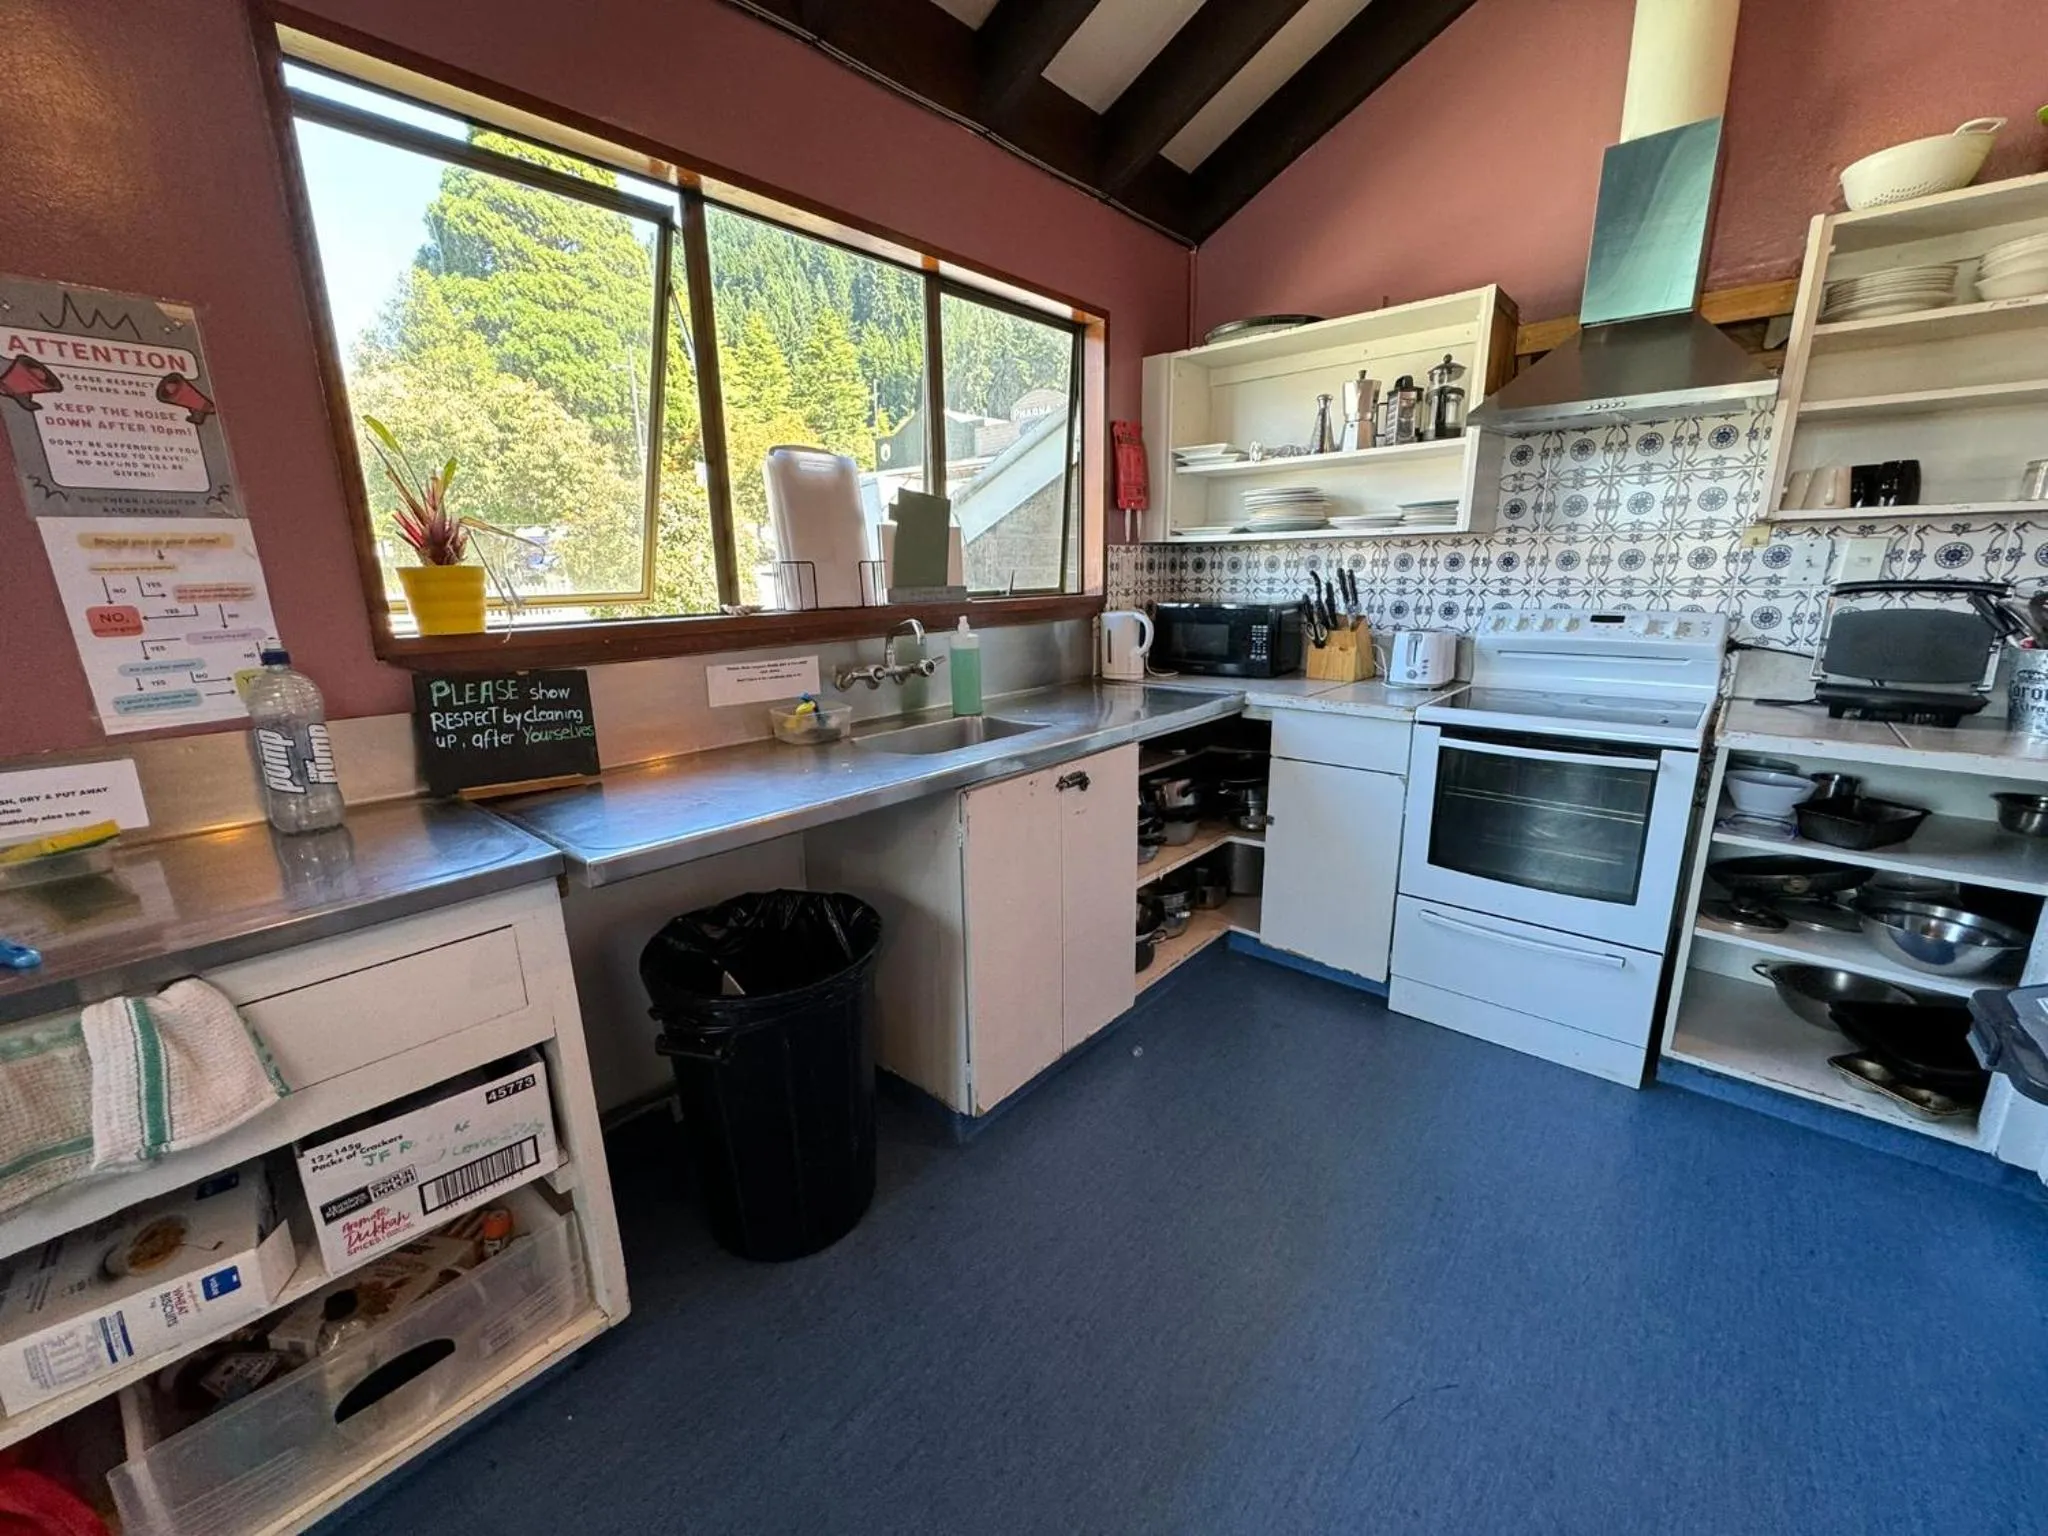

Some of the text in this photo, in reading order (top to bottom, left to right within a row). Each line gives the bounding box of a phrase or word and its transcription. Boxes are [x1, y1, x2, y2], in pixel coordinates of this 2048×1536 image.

[8, 335, 188, 373] ATTENTION
[59, 373, 155, 389] PLEASE RESPECT
[74, 384, 147, 398] OTHERS AND
[53, 401, 178, 422] KEEP THE NOISE
[44, 416, 193, 438] DOWN AFTER 10pm!
[48, 438, 84, 446] DON'T
[430, 680, 571, 707] PLEASE show
[430, 704, 584, 732] RESPECT by cleaning
[472, 728, 515, 749] after
[257, 727, 307, 794] pump
[19, 795, 42, 804] DRY
[55, 791, 76, 799] PUT
[79, 787, 109, 797] AWAY
[487, 1074, 536, 1103] 45773
[311, 1133, 404, 1174] Packs of Crackers
